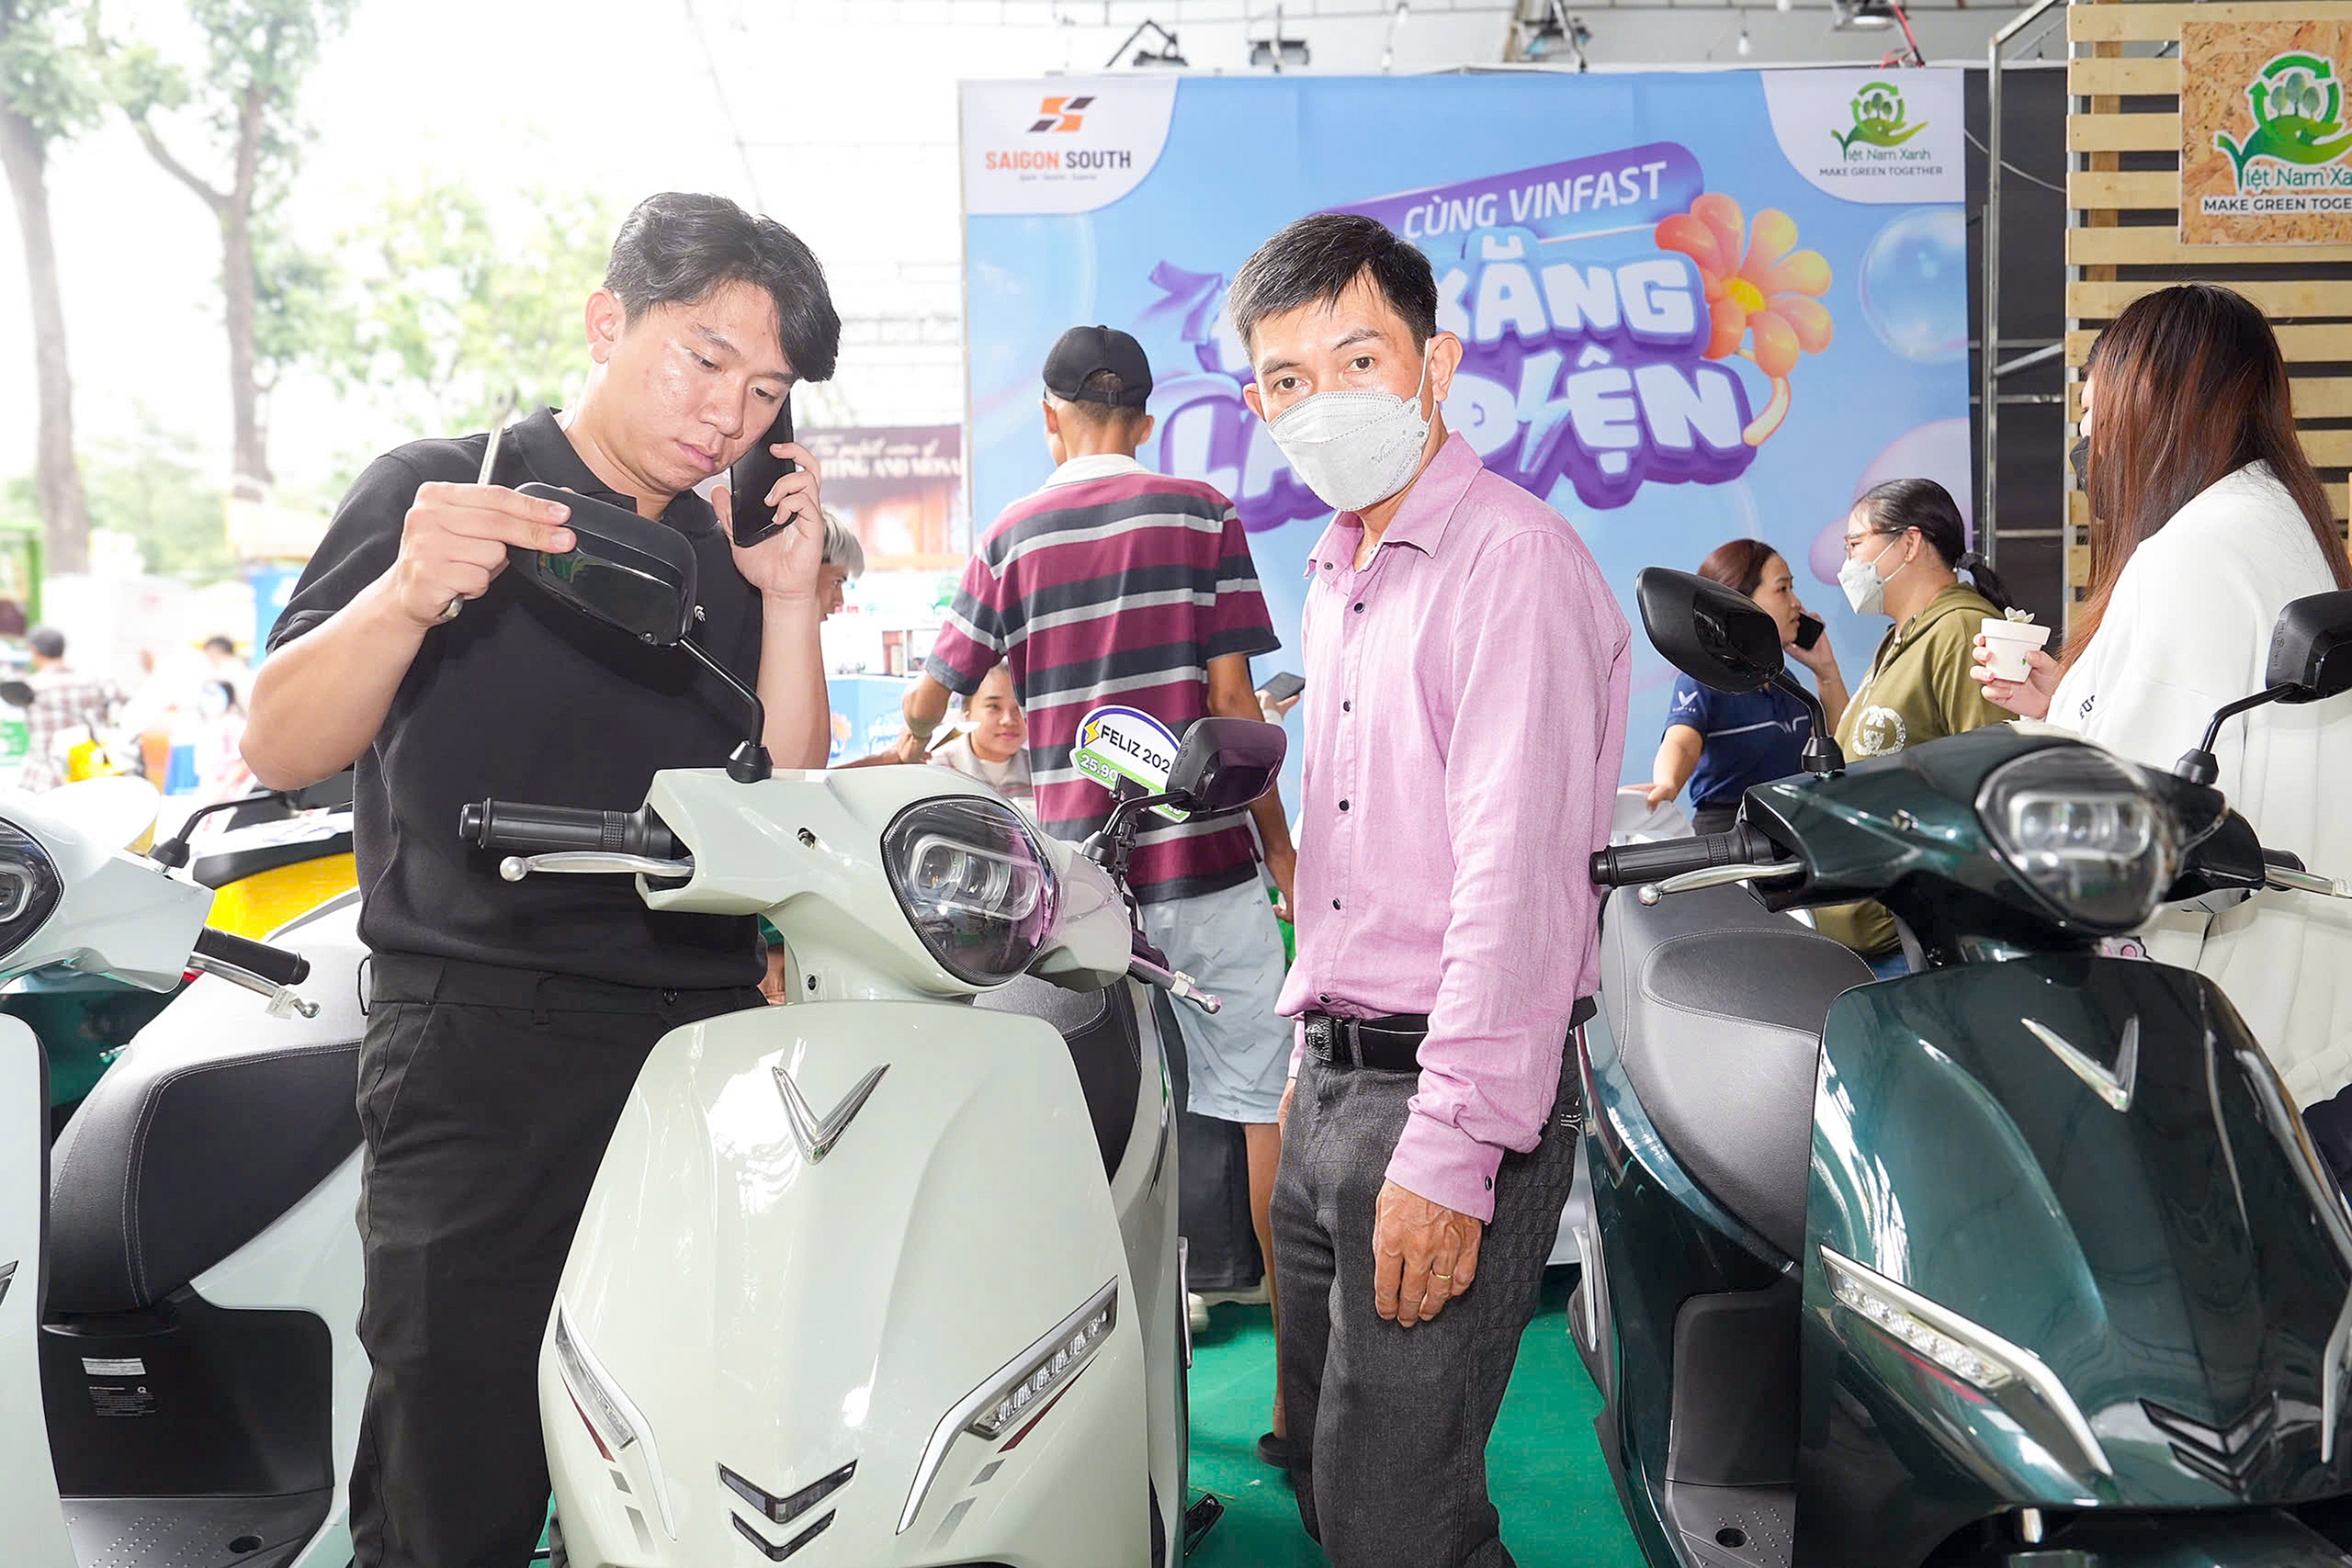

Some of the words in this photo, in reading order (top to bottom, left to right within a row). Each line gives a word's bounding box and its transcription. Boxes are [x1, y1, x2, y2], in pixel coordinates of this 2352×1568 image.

[985, 150, 1060, 170] SAIGON
[1066, 150, 1132, 169] SOUTH
[1867, 149, 1896, 161] Nam
[1899, 148, 1931, 161] Xanh
[1819, 167, 1849, 177] MAKE
[1851, 167, 1886, 176] GREEN
[1889, 166, 1943, 176] TOGETHER
[2276, 167, 2324, 186] Nam
[2330, 167, 2352, 186] Xa
[1403, 193, 1498, 240] CÙNG
[1509, 161, 1668, 222] VINFAST
[2204, 198, 2249, 211] MAKE
[2254, 197, 2306, 210] GREEN
[2311, 197, 2352, 210] TOGE
[1100, 724, 1141, 758] FELIZ
[1142, 748, 1170, 774] 202
